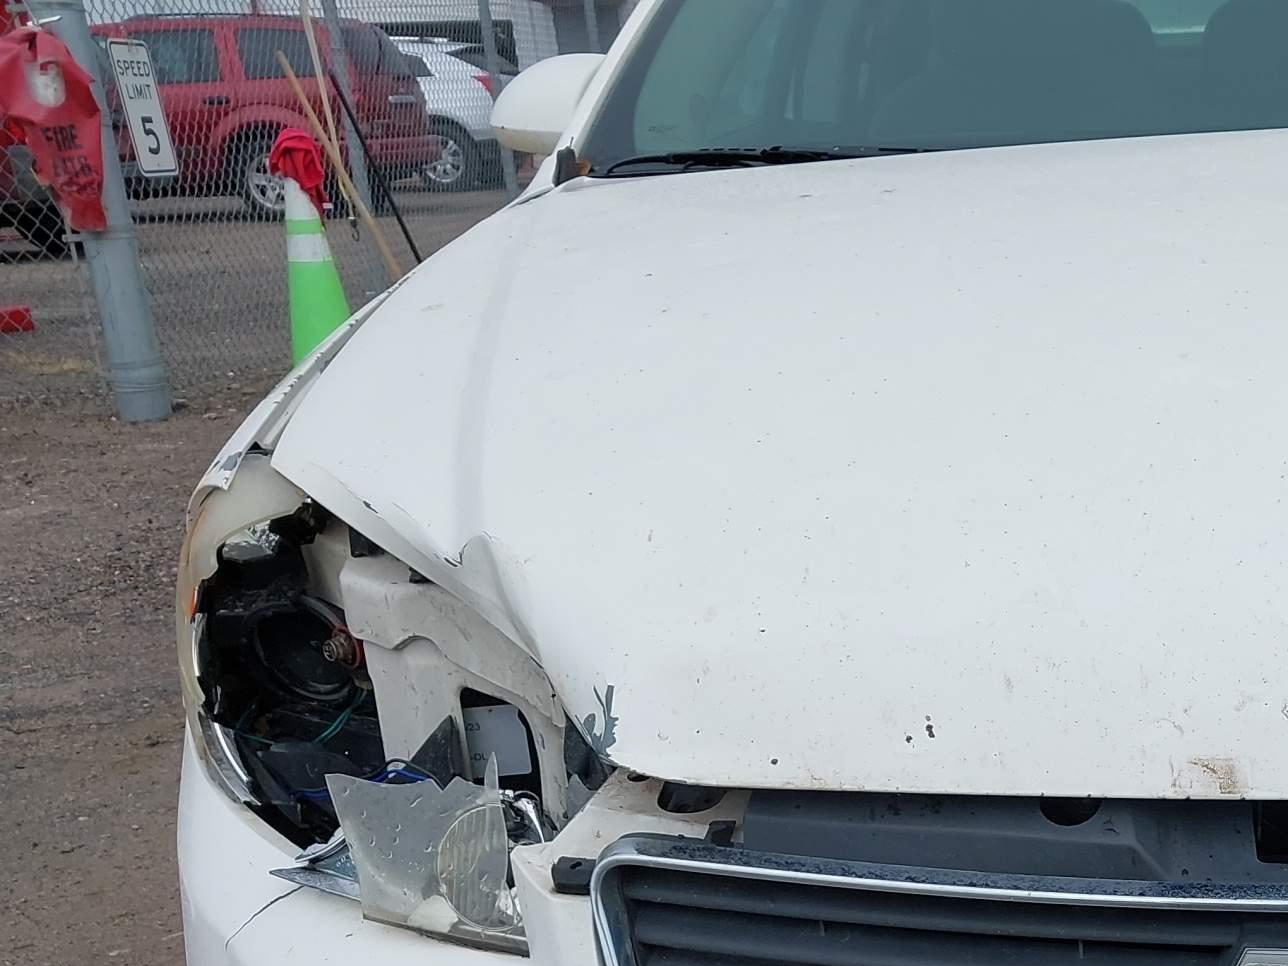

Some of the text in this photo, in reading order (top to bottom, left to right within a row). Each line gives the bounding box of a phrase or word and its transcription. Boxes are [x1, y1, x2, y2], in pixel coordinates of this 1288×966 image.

[116, 60, 151, 77] SPEED
[125, 84, 152, 100] LIMIT
[41, 124, 82, 152] FIRE
[141, 116, 161, 155] 5
